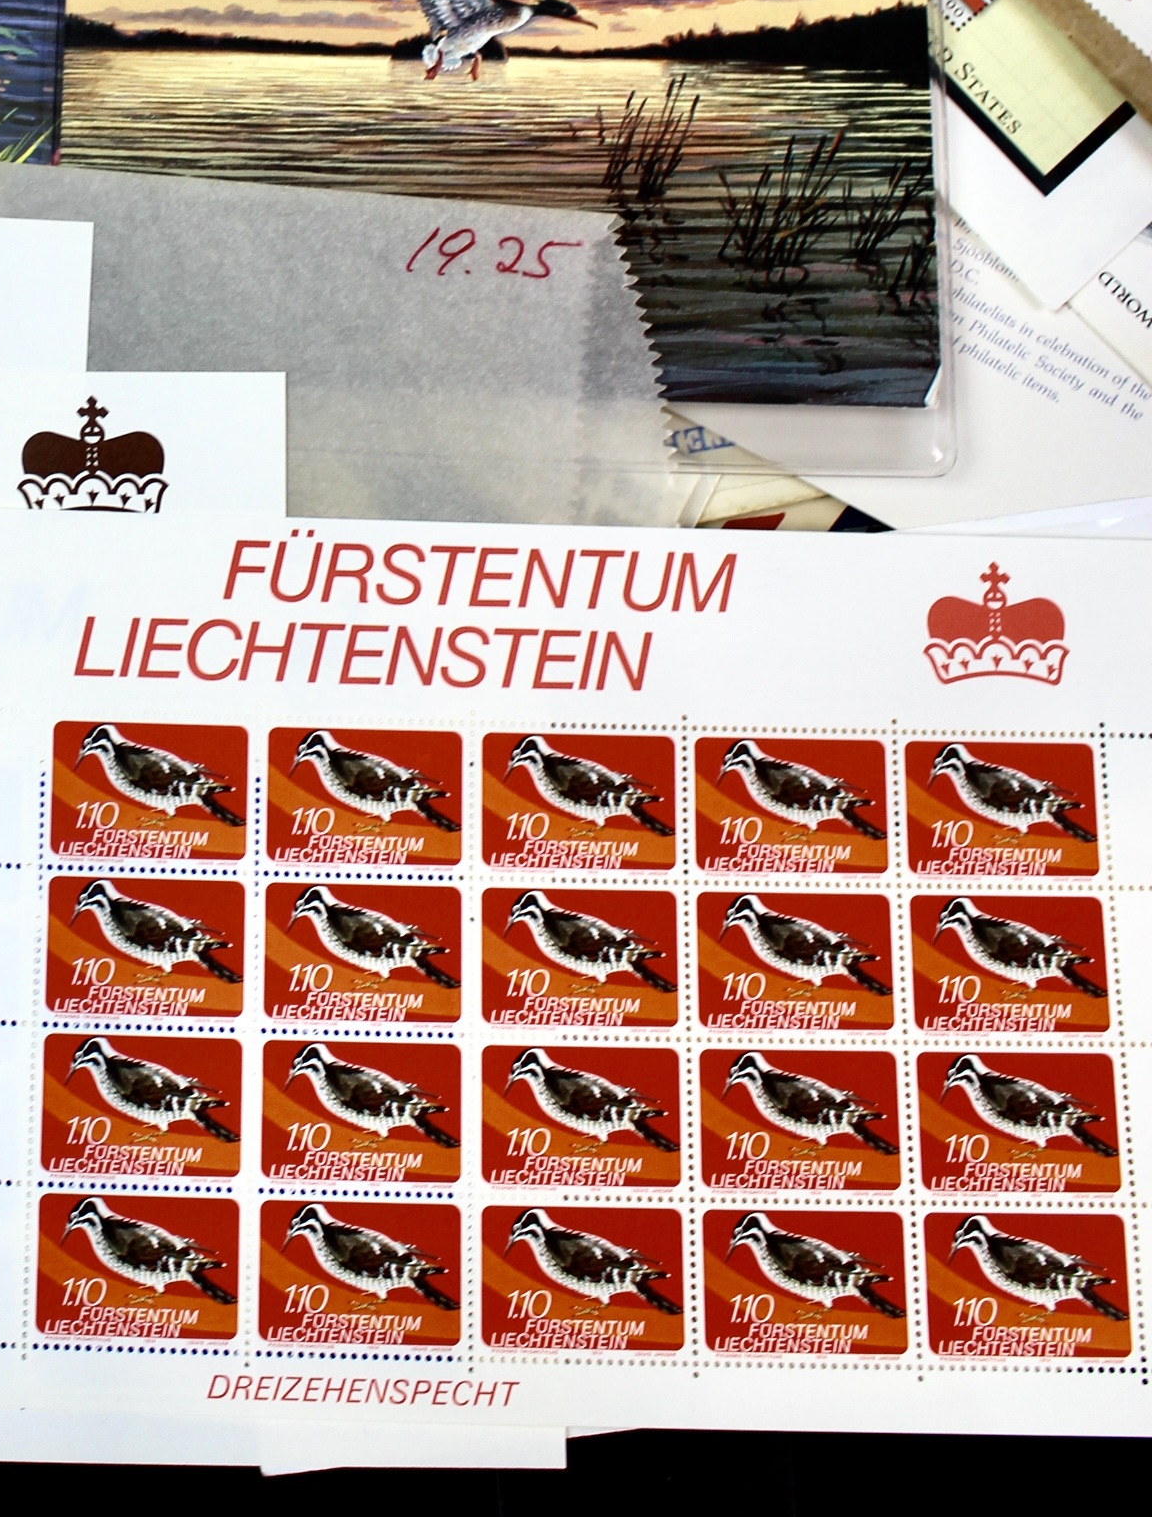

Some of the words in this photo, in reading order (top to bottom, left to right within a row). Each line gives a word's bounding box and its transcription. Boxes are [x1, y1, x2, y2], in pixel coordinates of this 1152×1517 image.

[405, 226, 584, 279] 19.25
[950, 259, 980, 285] D.C.
[1098, 270, 1152, 330] WORLD
[958, 341, 1023, 382] philatelic
[1021, 372, 1061, 404] items.
[968, 319, 1032, 361] Philatelic
[1034, 354, 1086, 392] Society
[1088, 387, 1119, 408] and
[1120, 400, 1145, 422] the
[1019, 321, 1034, 338] in
[1036, 332, 1110, 379] celebration
[1111, 374, 1131, 391] of
[1130, 381, 1152, 402] the
[223, 529, 737, 614] FÜRSTENTUM
[74, 615, 652, 692] LIECHTENSTEIN
[75, 801, 120, 829] 1.10
[291, 807, 335, 835] 1.10
[931, 820, 974, 847] 1.10
[58, 840, 191, 860] LIECHTENSTEIN
[275, 846, 407, 865] LIECHTENSTEIN
[917, 858, 1045, 876] LIECHTENSTEIN
[71, 958, 115, 985] 1.10
[722, 973, 766, 1000] 1.10
[54, 997, 188, 1017] LIECHTENSTEIN
[707, 1012, 839, 1030] LIECHTENSTEIN
[286, 1122, 331, 1151] 1.10
[270, 1164, 405, 1182] LIECHTENSTEIN
[61, 1278, 107, 1307] 1.10
[952, 1297, 997, 1326] 1.10
[45, 1319, 180, 1339] LIECHTENSTEIN
[938, 1339, 1076, 1357] LIECHTENSTEIN
[206, 1373, 520, 1409] DREIZEHENSPECHT
